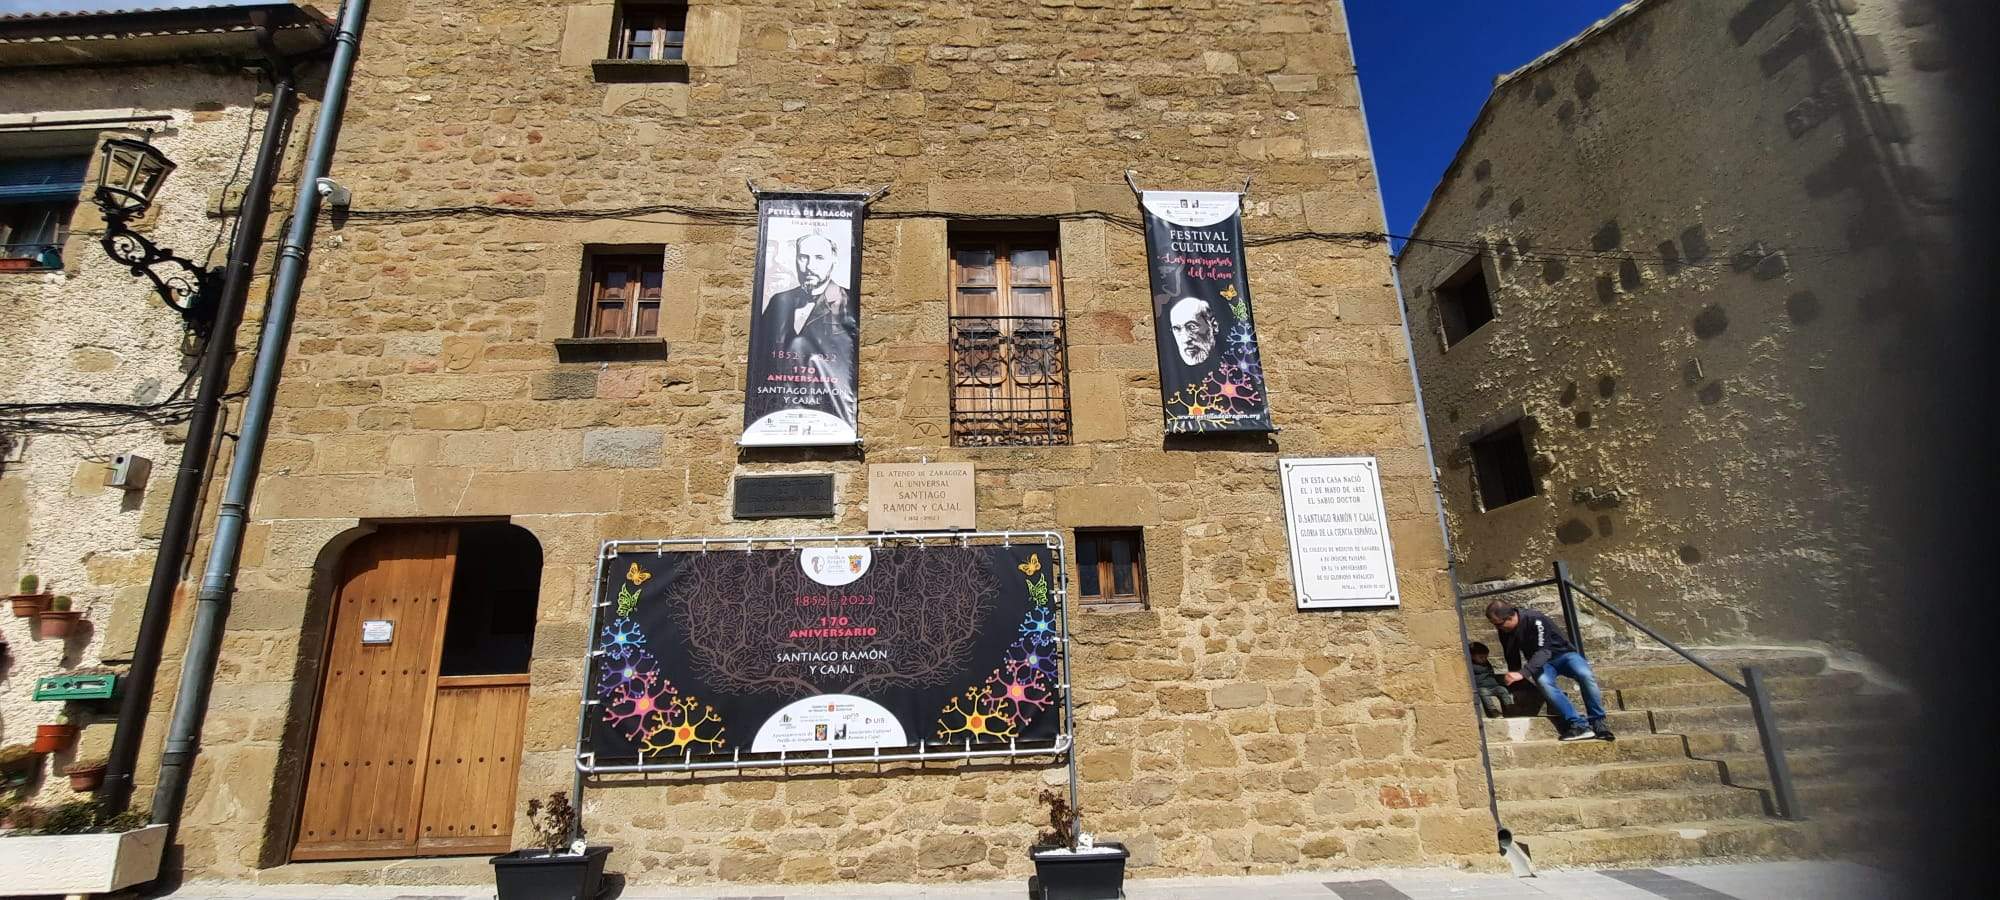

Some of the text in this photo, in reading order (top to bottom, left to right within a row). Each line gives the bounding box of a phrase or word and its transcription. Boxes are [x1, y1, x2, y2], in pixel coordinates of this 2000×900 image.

[803, 208, 814, 217] DE
[816, 209, 853, 218] ARAGÓN
[1170, 229, 1229, 241] FESTIVAL
[1171, 242, 1231, 254] CULTURAL
[771, 350, 800, 360] 1852
[793, 366, 816, 374] 170
[767, 374, 839, 384] ANIVERSARIO
[757, 386, 807, 395] SANTIAGO
[783, 396, 821, 405] Y CAJAL
[908, 480, 950, 488] UNIVERSAL
[1310, 476, 1325, 484] ESTA
[1343, 474, 1361, 483] NACIÓ
[898, 490, 947, 499] SANTIAGO
[883, 503, 918, 512] RAMON
[931, 503, 961, 512] CAJAL
[1332, 512, 1352, 523] RAMÓN
[1353, 513, 1357, 522] Y
[1359, 512, 1376, 522] CAJAL
[1300, 529, 1318, 537] GLORIA
[1319, 529, 1326, 537] DE
[1334, 528, 1353, 536] CIENCIA
[1353, 526, 1378, 536] ESPAÑOLA
[795, 595, 827, 606] 1852
[841, 595, 876, 606] 2022
[820, 617, 849, 626] 170
[789, 627, 877, 638] ANIVERSARIO
[777, 648, 888, 663] SANTIAGO RAMÓN
[809, 664, 855, 674] Y CAJAL
